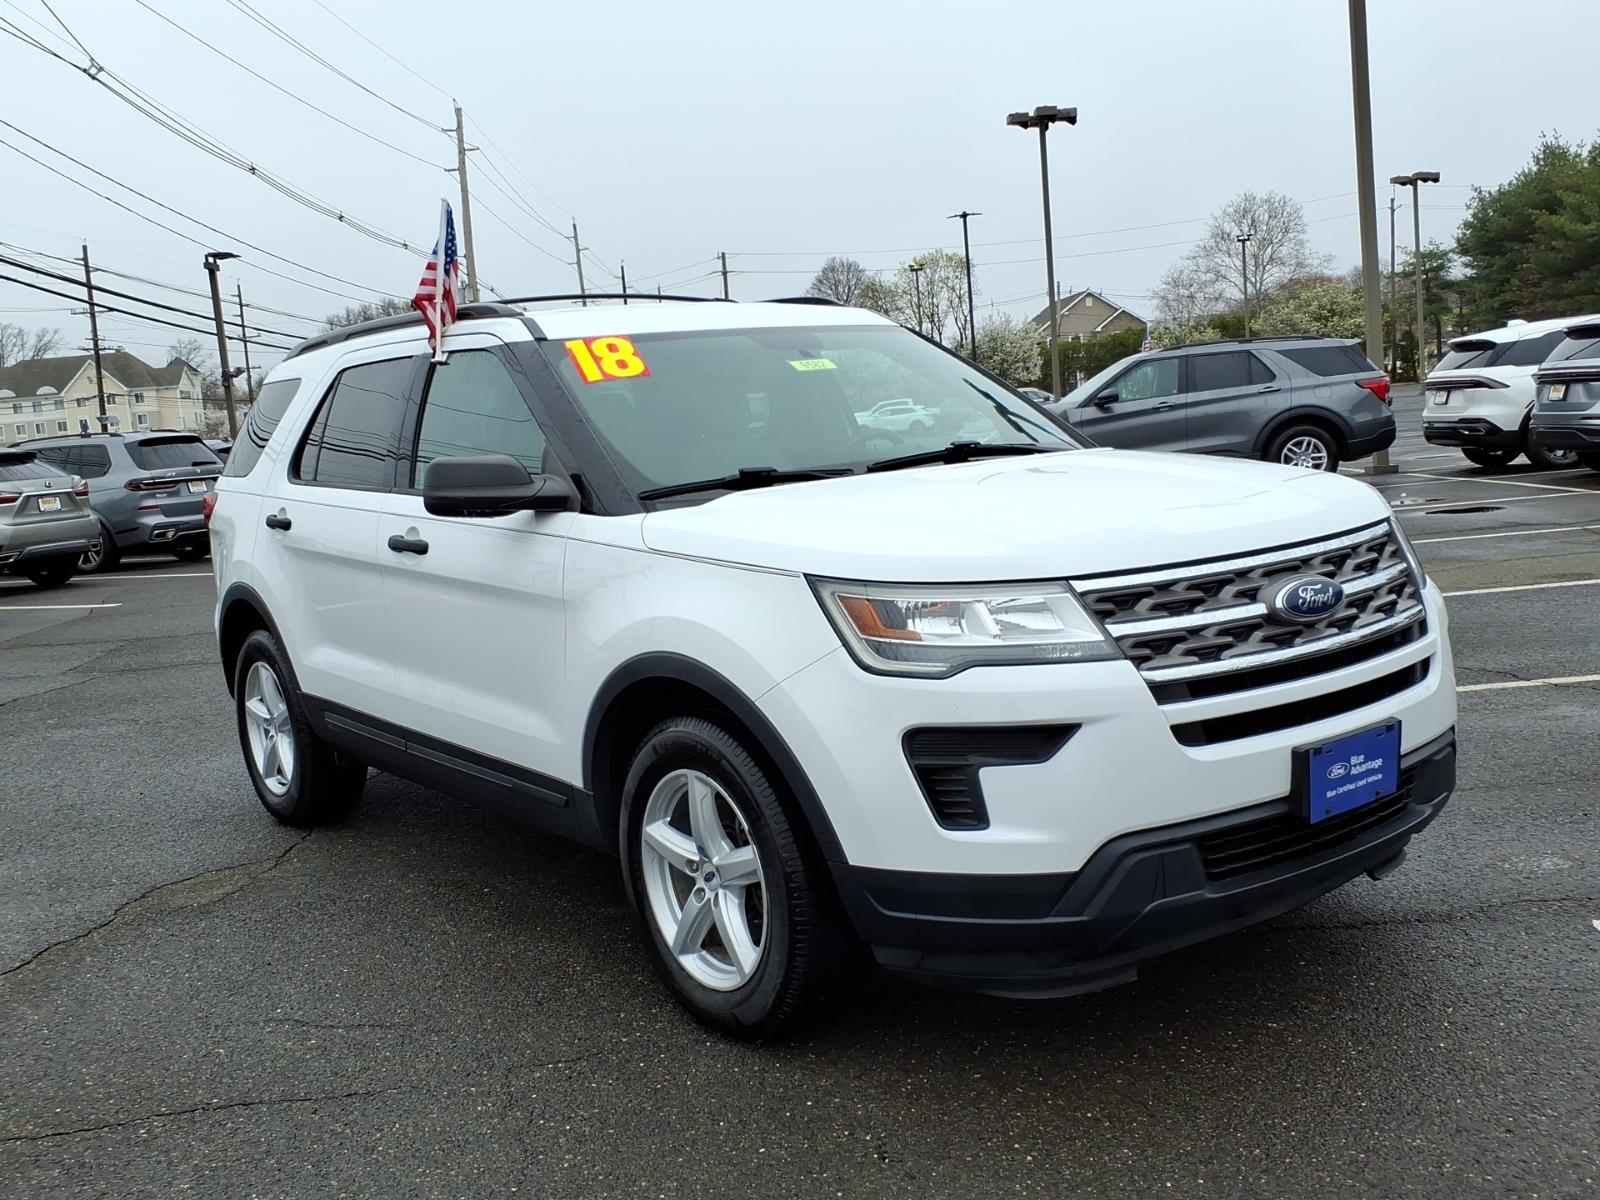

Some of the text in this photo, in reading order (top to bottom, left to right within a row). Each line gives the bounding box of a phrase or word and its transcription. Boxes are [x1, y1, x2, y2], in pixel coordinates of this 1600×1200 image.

[564, 336, 645, 383] 18
[1298, 583, 1335, 609] Ford
[1350, 754, 1365, 765] Blue
[1350, 758, 1382, 775] Advantage
